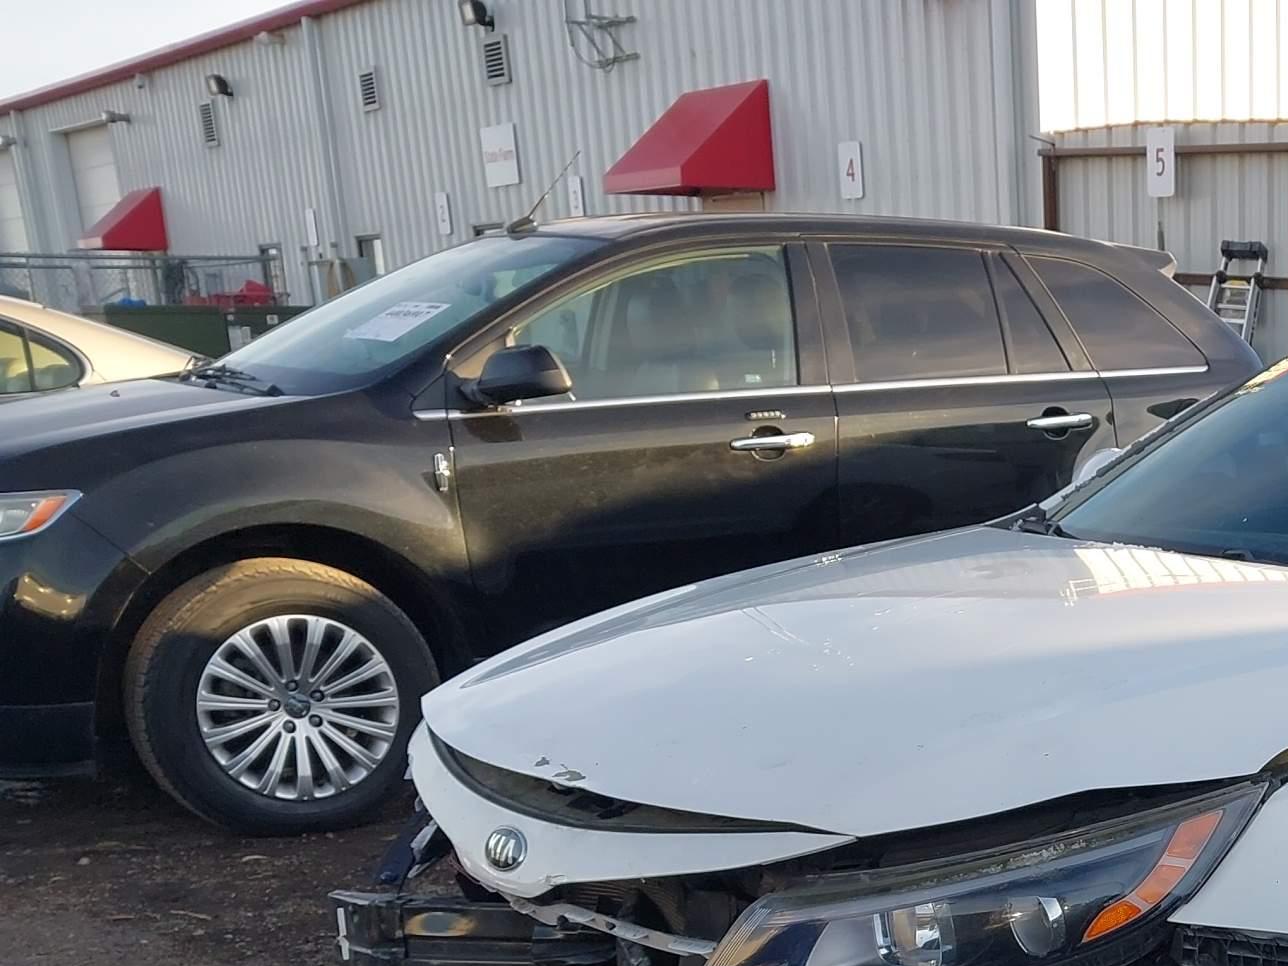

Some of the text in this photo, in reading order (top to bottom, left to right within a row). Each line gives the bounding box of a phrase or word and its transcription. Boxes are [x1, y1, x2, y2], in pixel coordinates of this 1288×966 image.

[846, 158, 855, 182] 4
[1156, 147, 1165, 177] 5
[488, 833, 516, 864] KIA
